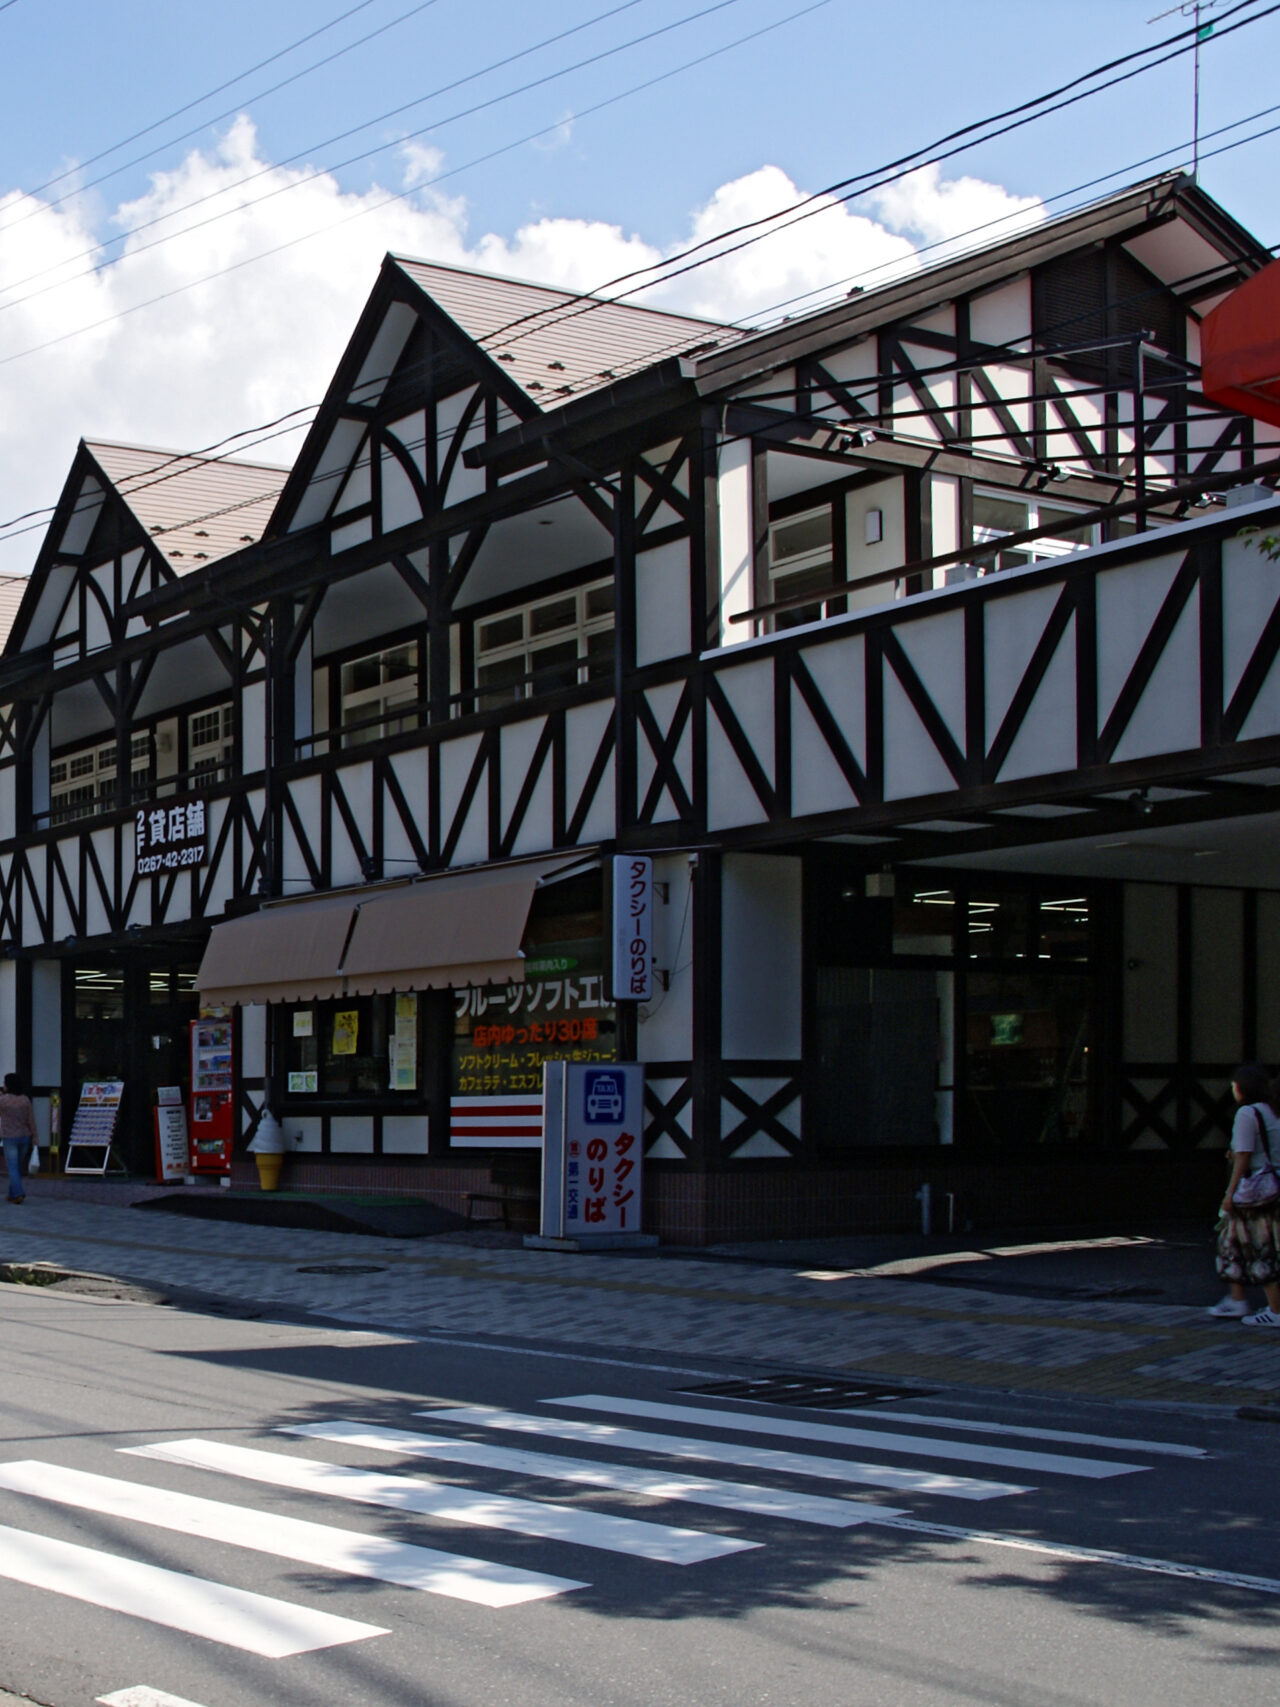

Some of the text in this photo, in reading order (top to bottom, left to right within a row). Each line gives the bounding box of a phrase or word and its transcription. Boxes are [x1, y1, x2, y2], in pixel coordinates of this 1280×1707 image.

[148, 800, 205, 847] 貸店舗
[629, 860, 647, 995] タクシーのりば
[455, 975, 616, 1019] フルーツソフト工
[472, 1018, 599, 1048] 店内ゆったり30席
[458, 1073, 544, 1092] カフェラテ・エスプレ
[596, 1084, 615, 1094] TAXI
[585, 1138, 608, 1224] のりば
[612, 1132, 635, 1228] タクシー
